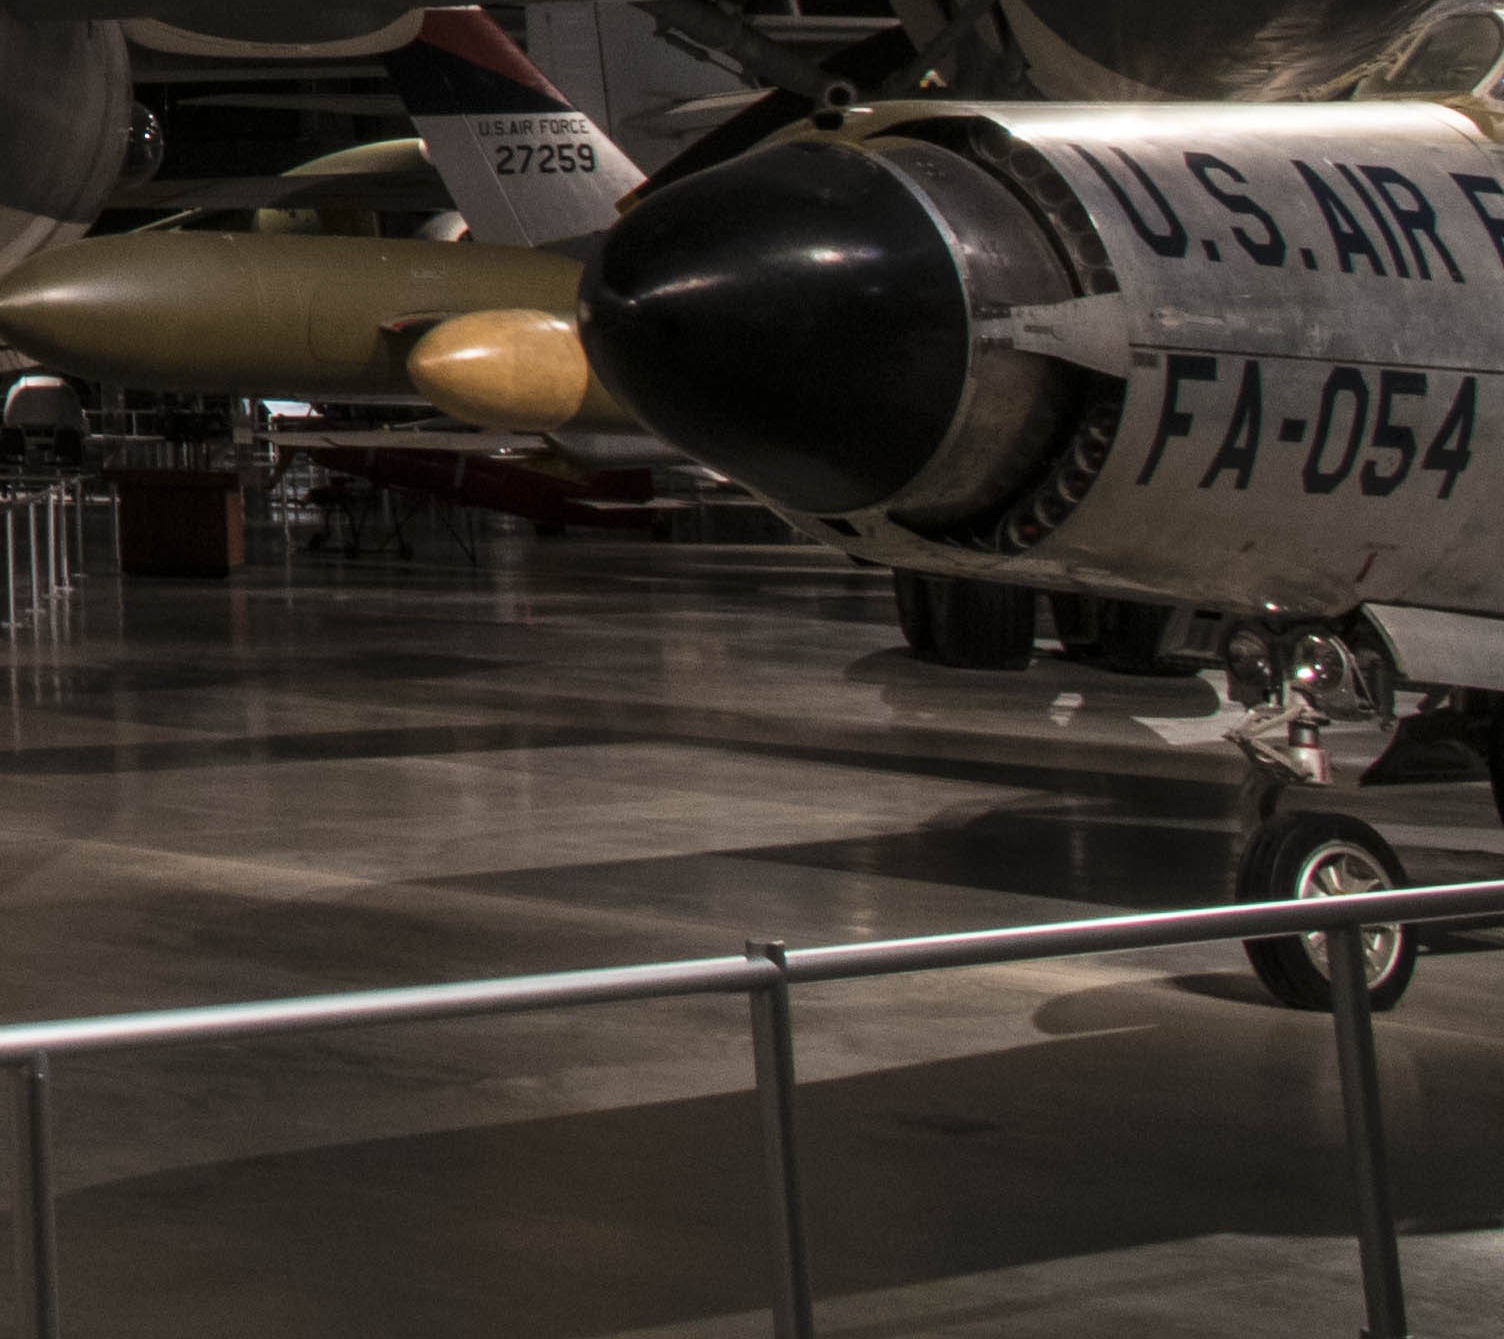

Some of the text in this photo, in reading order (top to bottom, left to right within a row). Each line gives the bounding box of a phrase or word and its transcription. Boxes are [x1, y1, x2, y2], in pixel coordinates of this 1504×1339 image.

[539, 118, 590, 135] FORCE
[495, 143, 596, 175] 27259
[1135, 353, 1477, 500] FA-054
